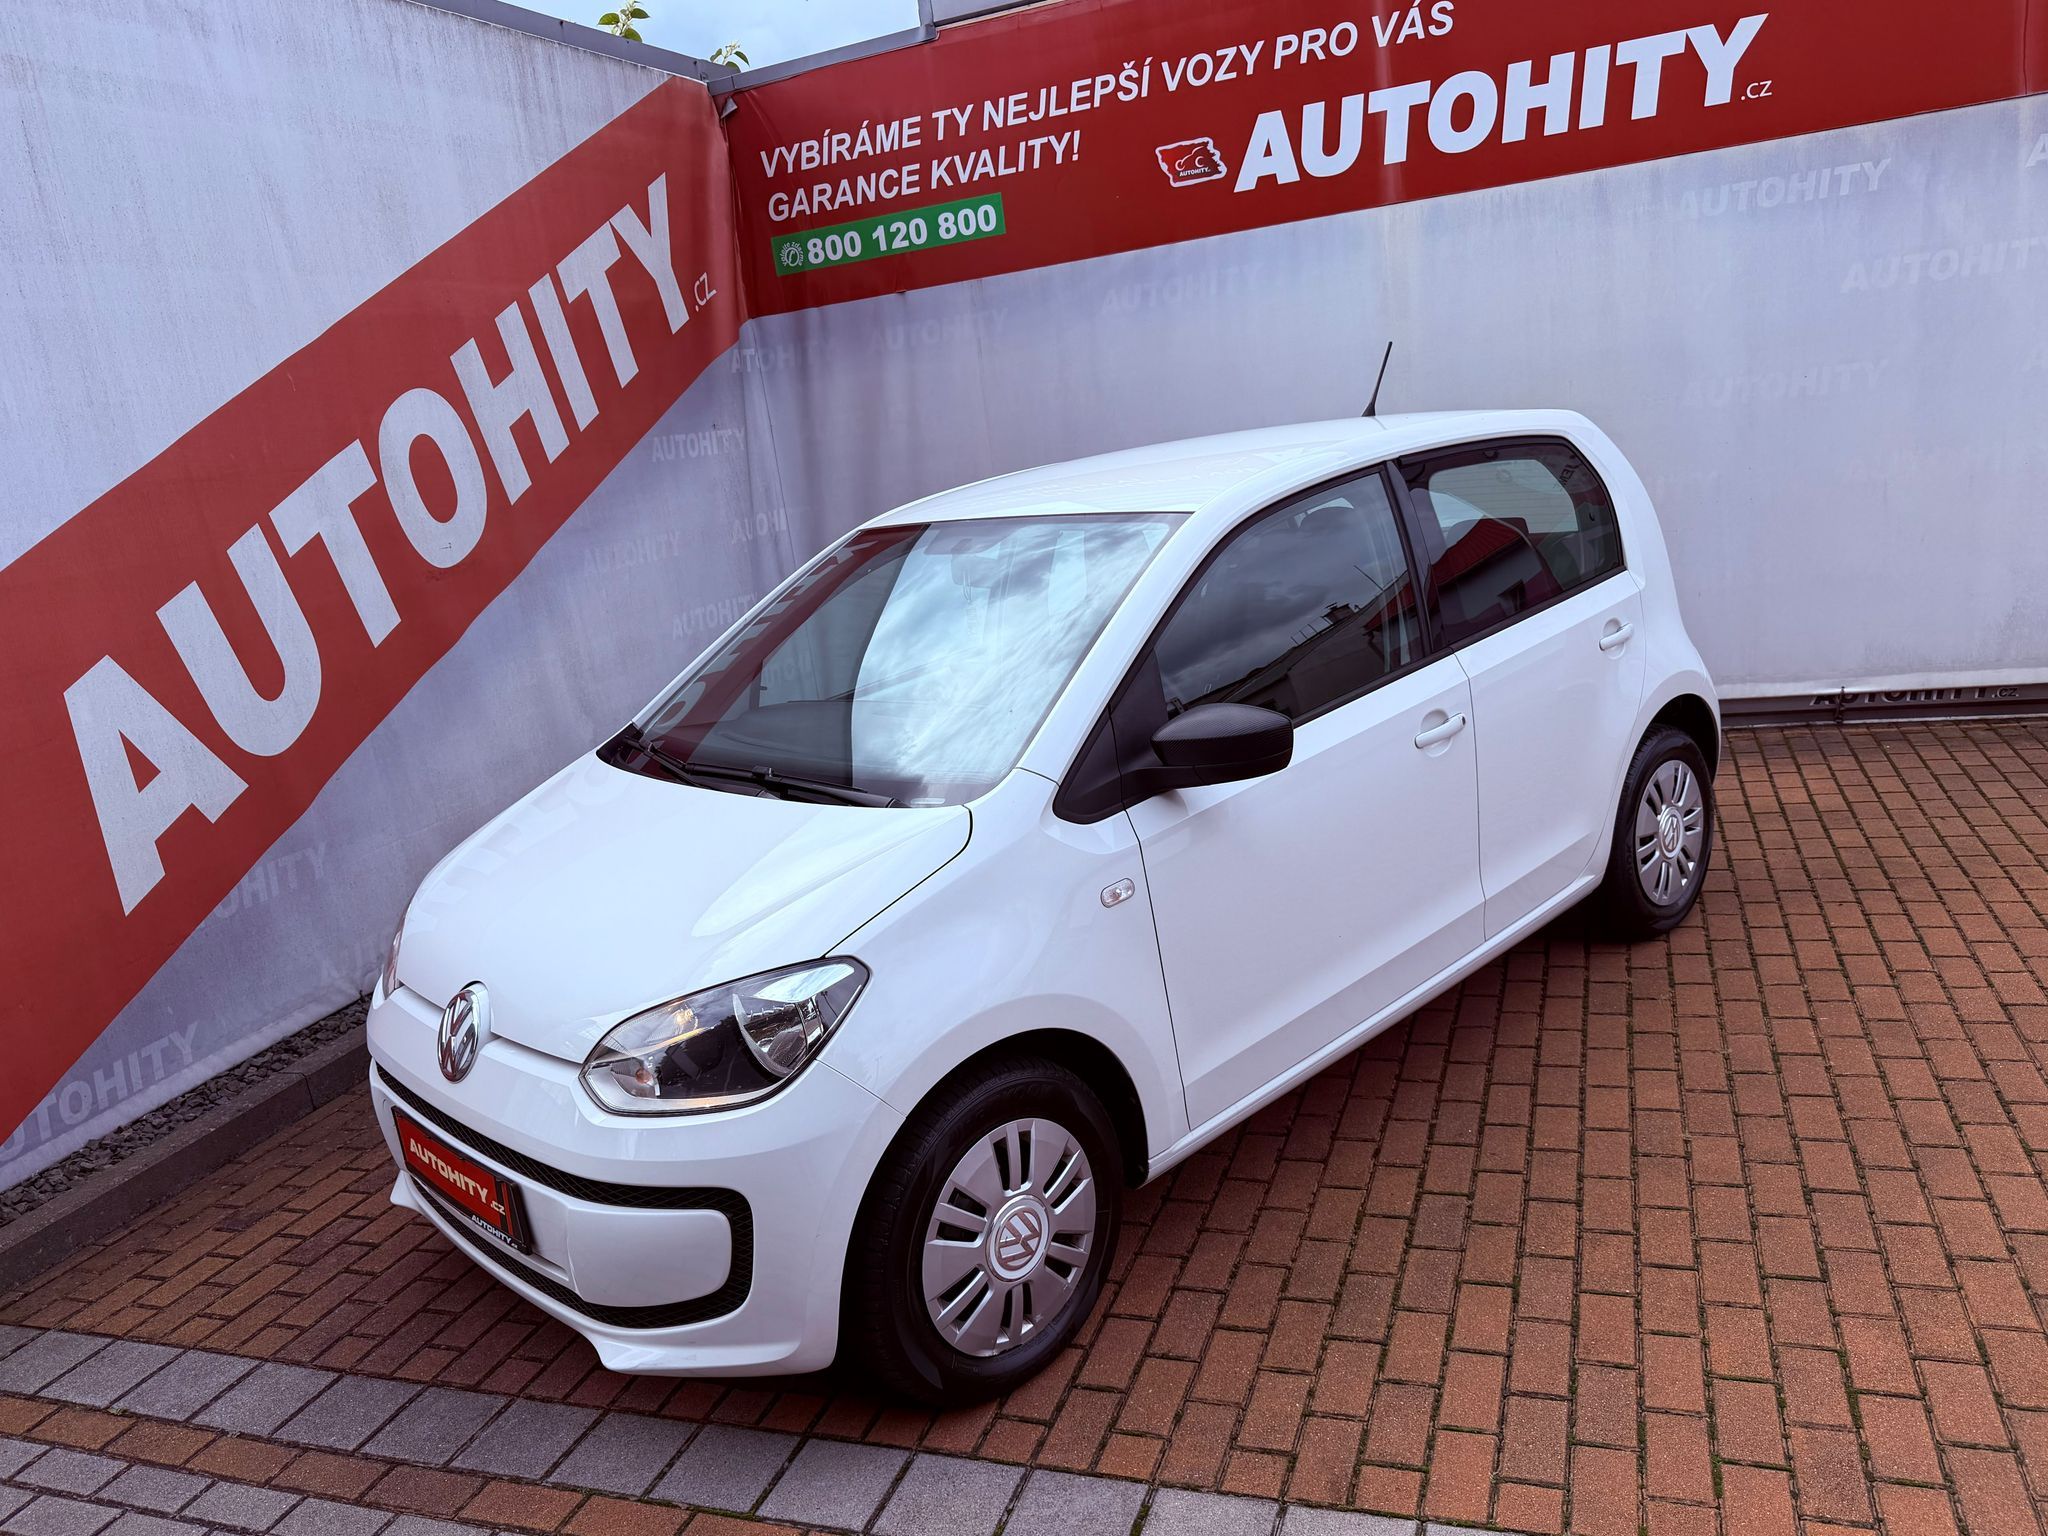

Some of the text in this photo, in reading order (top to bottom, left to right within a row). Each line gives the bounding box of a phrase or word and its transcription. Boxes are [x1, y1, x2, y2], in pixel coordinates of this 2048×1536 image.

[760, 0, 1455, 178] VYBÍRÁME TY NEJLEPŠÍ VOZY PRO VÁS
[768, 130, 1081, 222] GARANCE KVALITY!
[1682, 159, 1892, 220] AUTOHITY
[807, 204, 998, 266] 800 120 800
[1840, 235, 2048, 294] AUTOHIT
[652, 426, 746, 463] AUTOHITY
[471, 1214, 512, 1244] AUTOHITY
